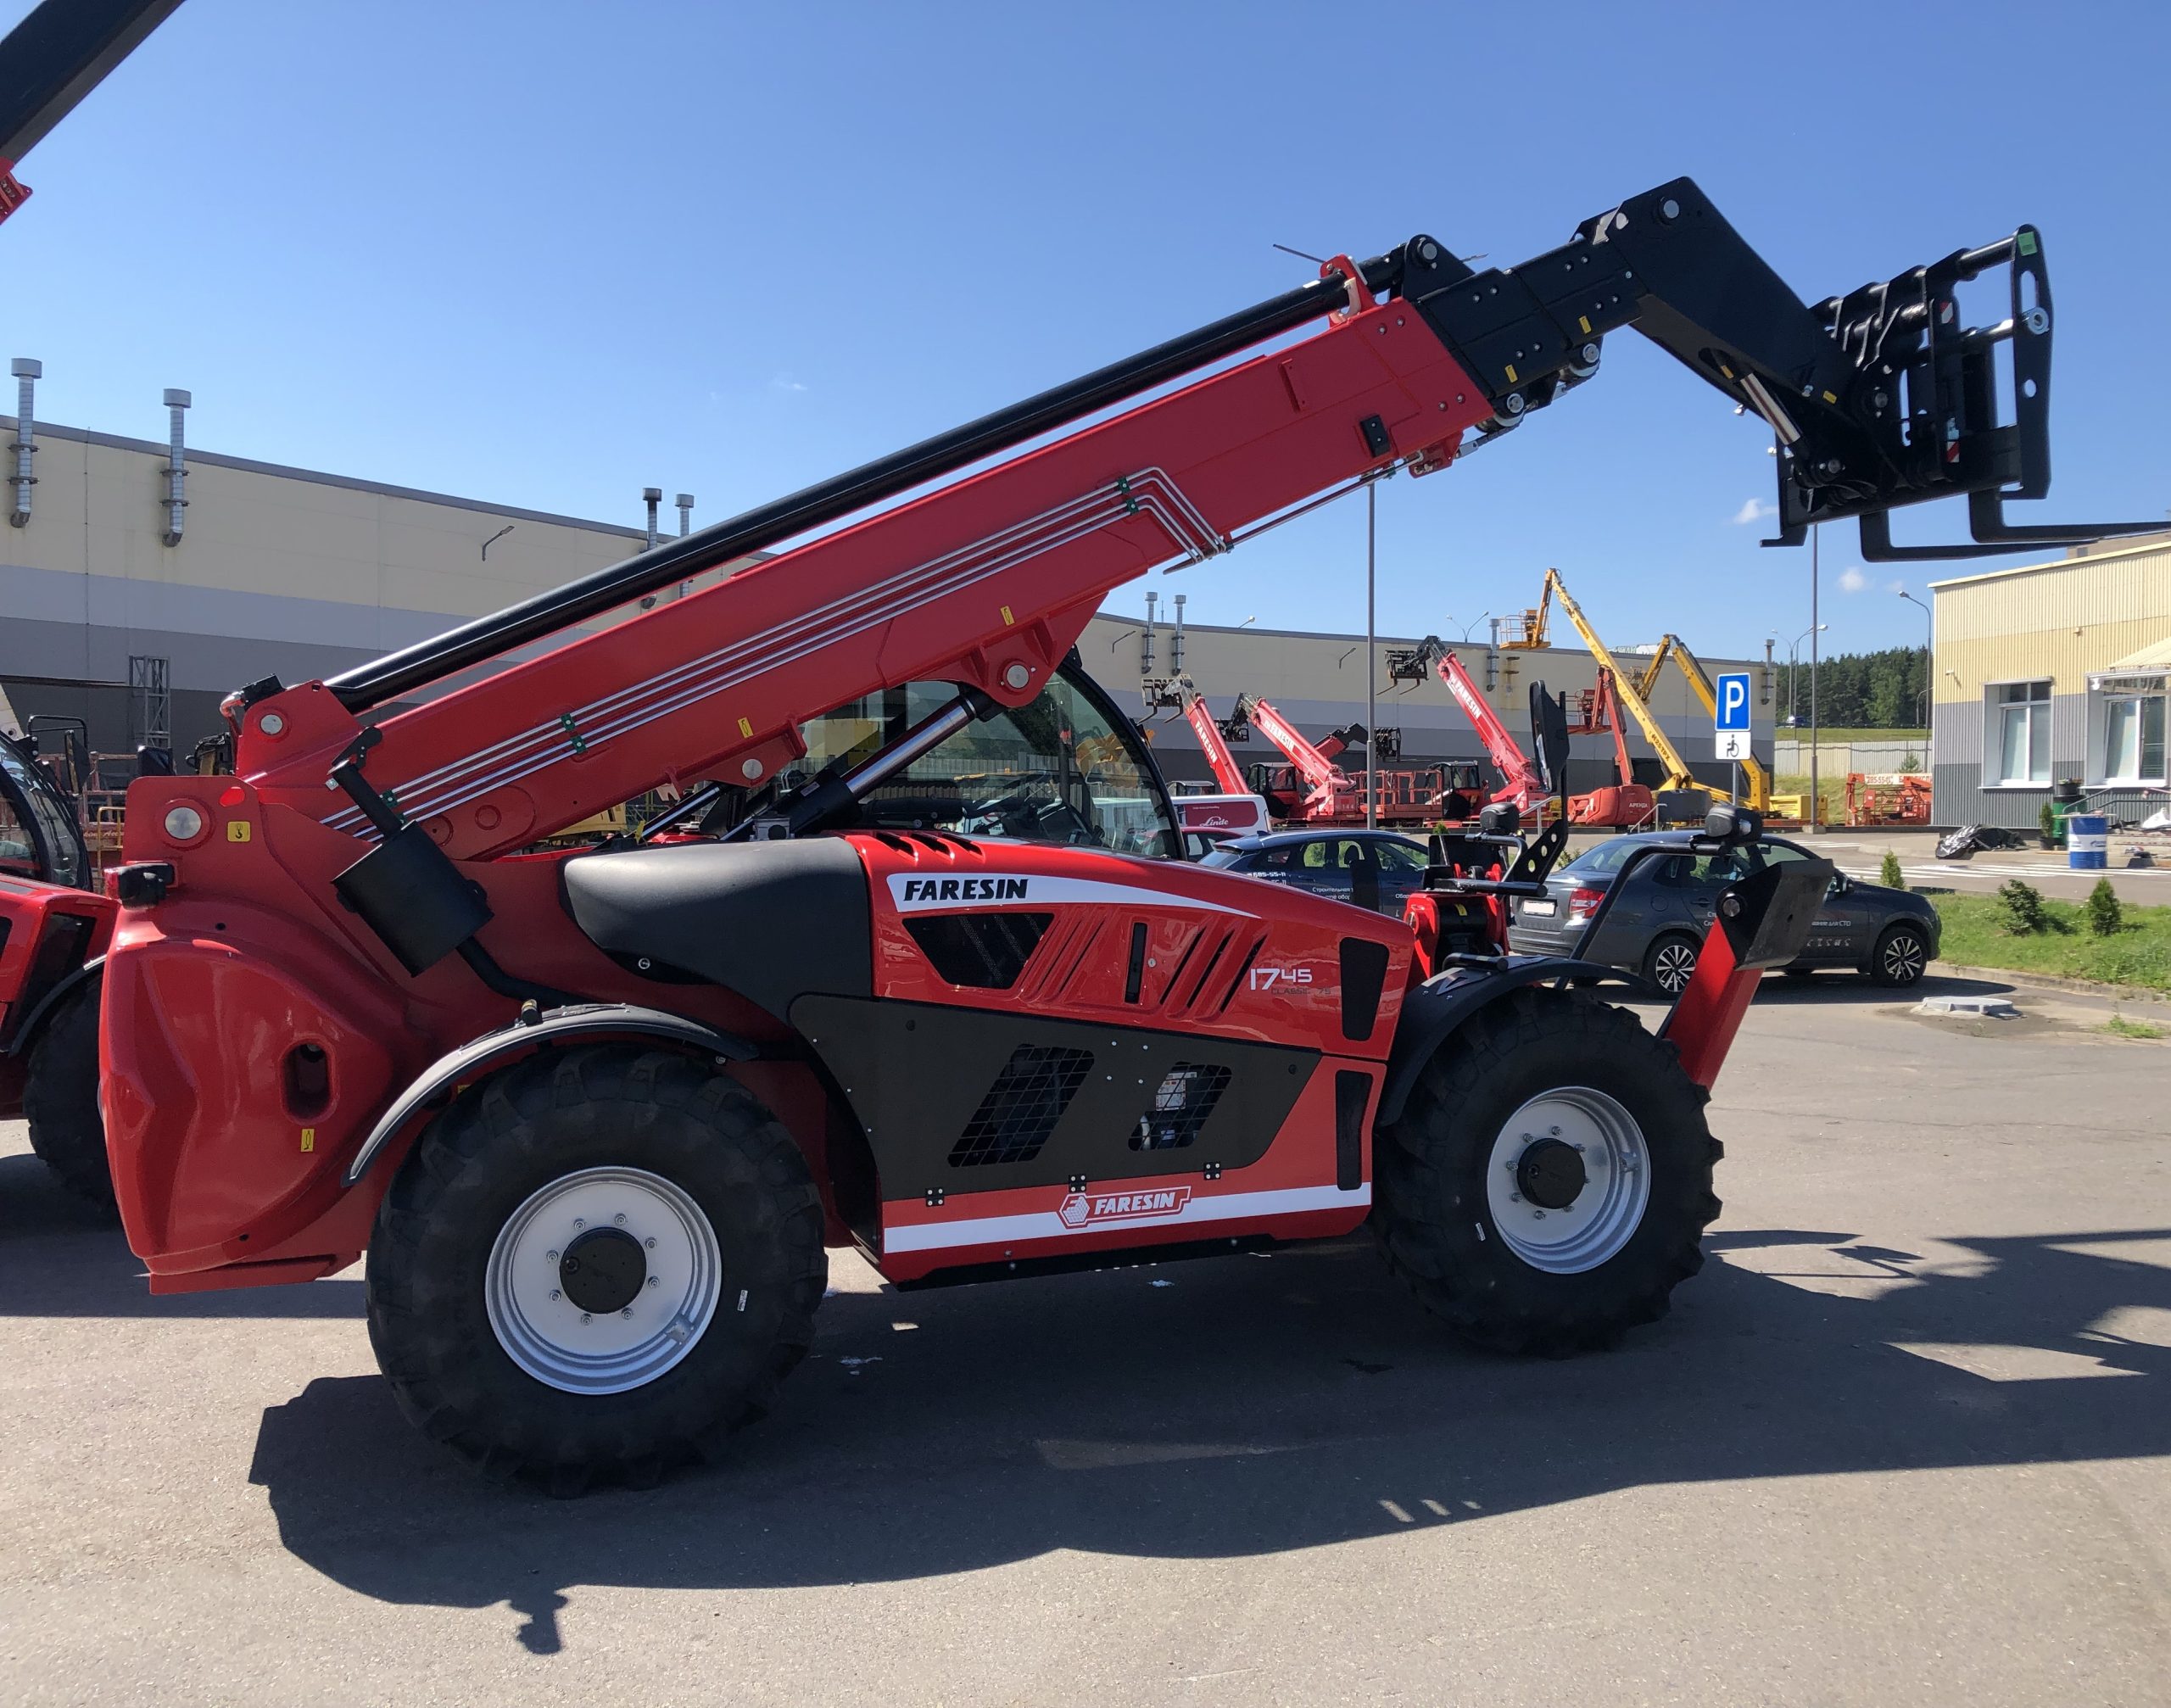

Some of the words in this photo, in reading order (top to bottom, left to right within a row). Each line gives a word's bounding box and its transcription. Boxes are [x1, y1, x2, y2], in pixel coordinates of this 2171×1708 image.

[1725, 681, 1744, 724] P
[1195, 720, 1218, 763] FARESIN
[1199, 816, 1229, 827] Linde
[903, 879, 1029, 901] FARESIN
[1094, 1192, 1175, 1214] FARESIN
